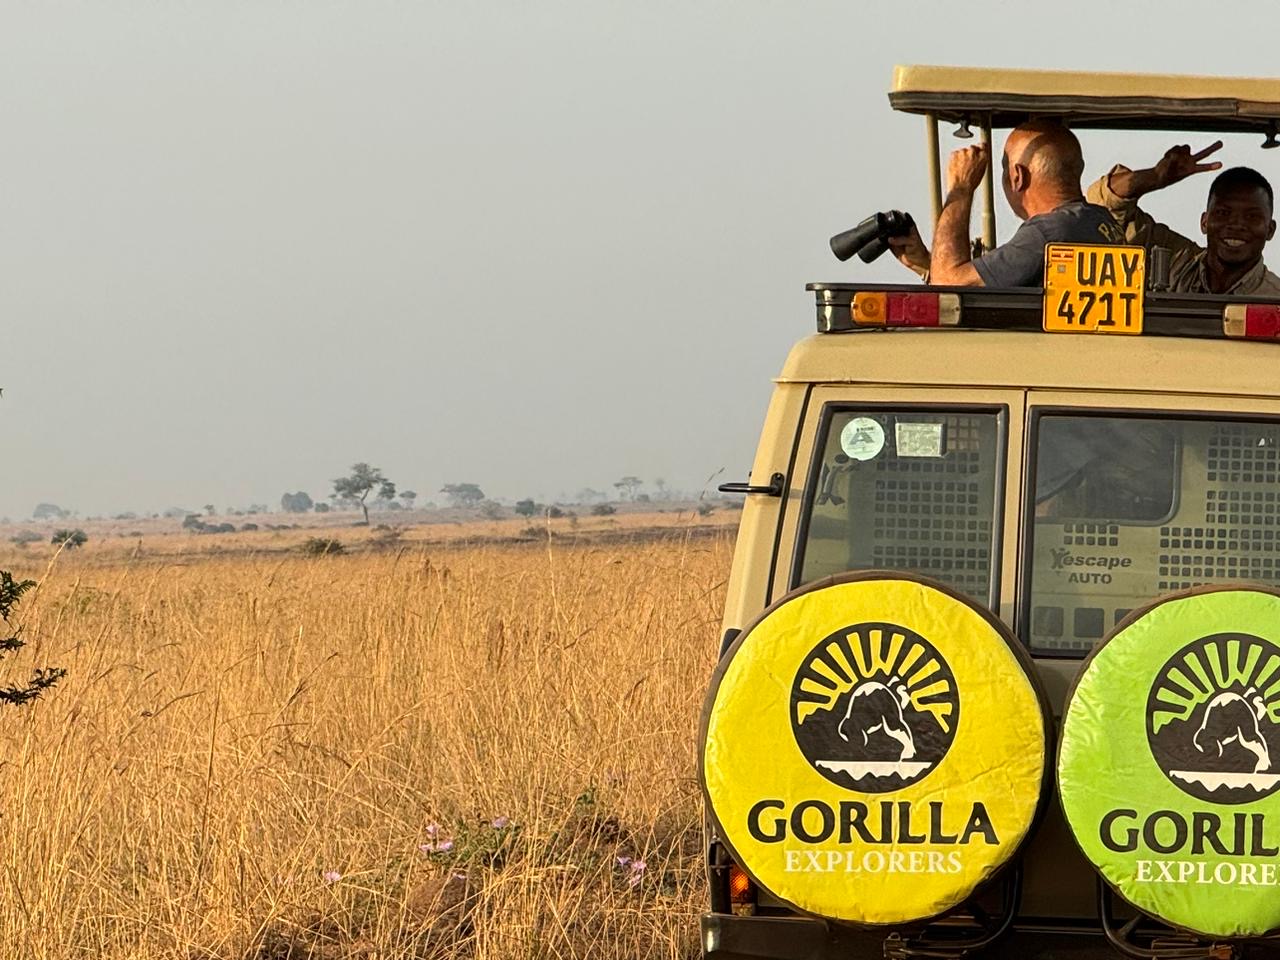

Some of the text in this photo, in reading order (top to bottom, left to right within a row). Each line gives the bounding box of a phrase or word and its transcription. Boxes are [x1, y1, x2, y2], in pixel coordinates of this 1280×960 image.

[1077, 251, 1140, 288] UAY
[1057, 290, 1138, 327] 471T
[1068, 573, 1112, 585] AUTO
[747, 799, 1001, 845] GORILLA
[783, 850, 963, 874] EXPLORERS
